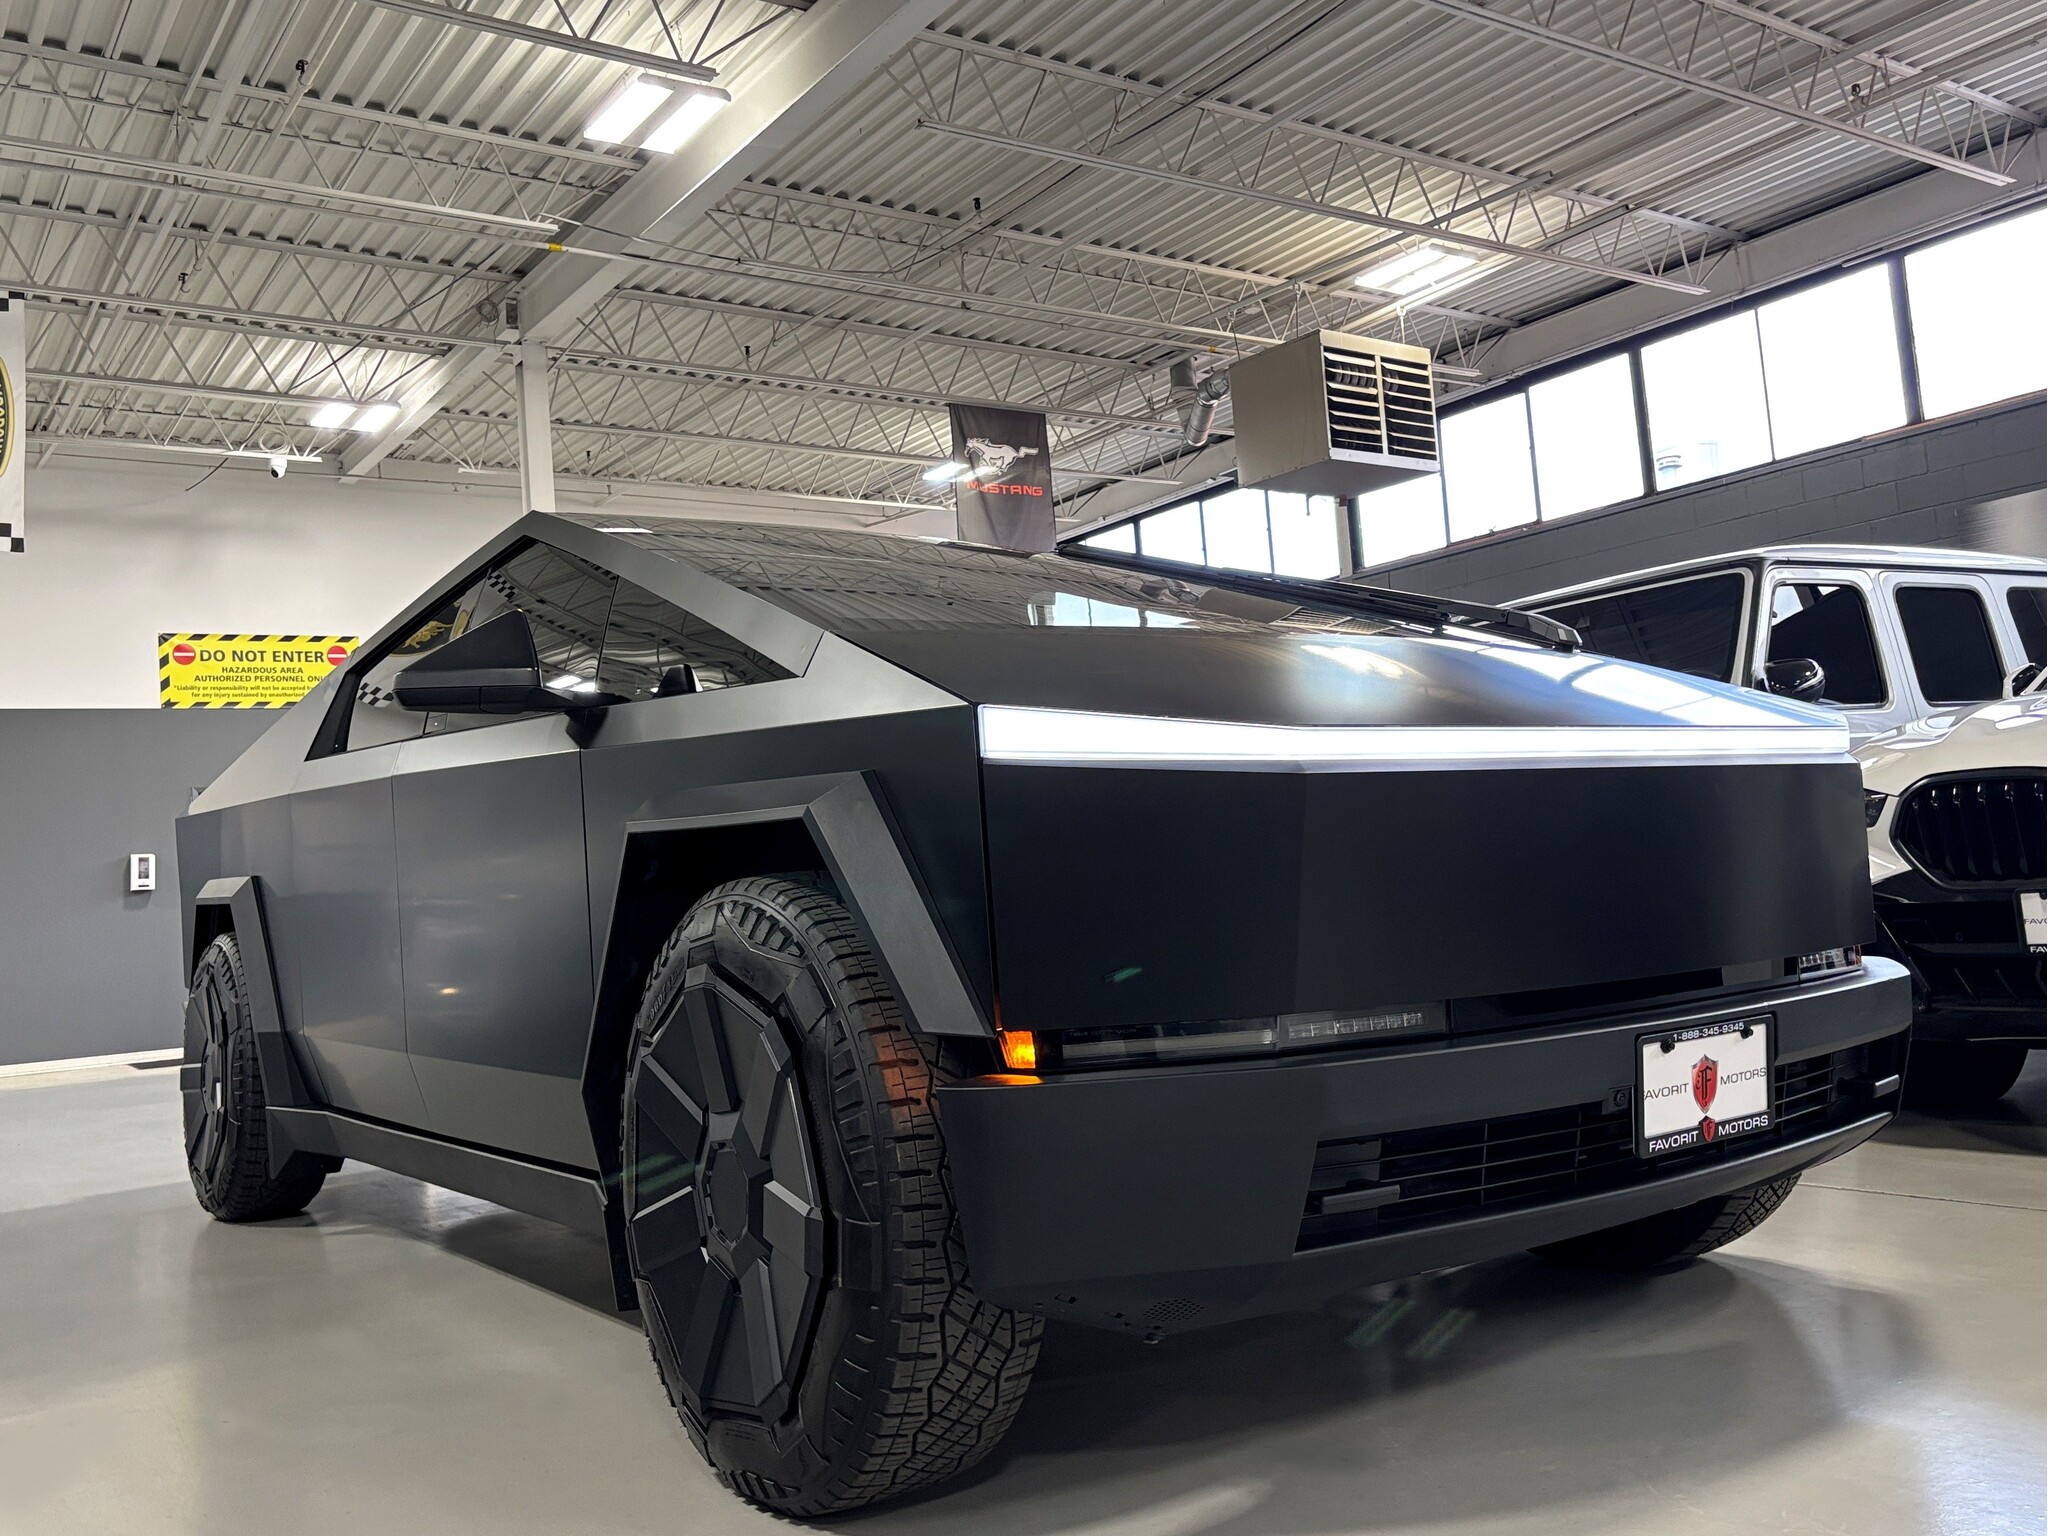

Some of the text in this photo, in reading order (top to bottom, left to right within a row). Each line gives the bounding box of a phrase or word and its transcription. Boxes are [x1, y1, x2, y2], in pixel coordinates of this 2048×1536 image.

[966, 480, 1043, 497] MUSTANG
[200, 649, 325, 663] DO NOT ENTER
[221, 666, 303, 674] HAZARDOUS AREA
[254, 675, 305, 683] PERSONNEL
[1673, 1022, 1745, 1041] 1-888-345-9345
[1643, 1082, 1690, 1101] AVORIT
[1720, 1067, 1768, 1086] MOTORS
[1649, 1131, 1699, 1153] FAVORIT
[1718, 1115, 1769, 1136] MOTORS
